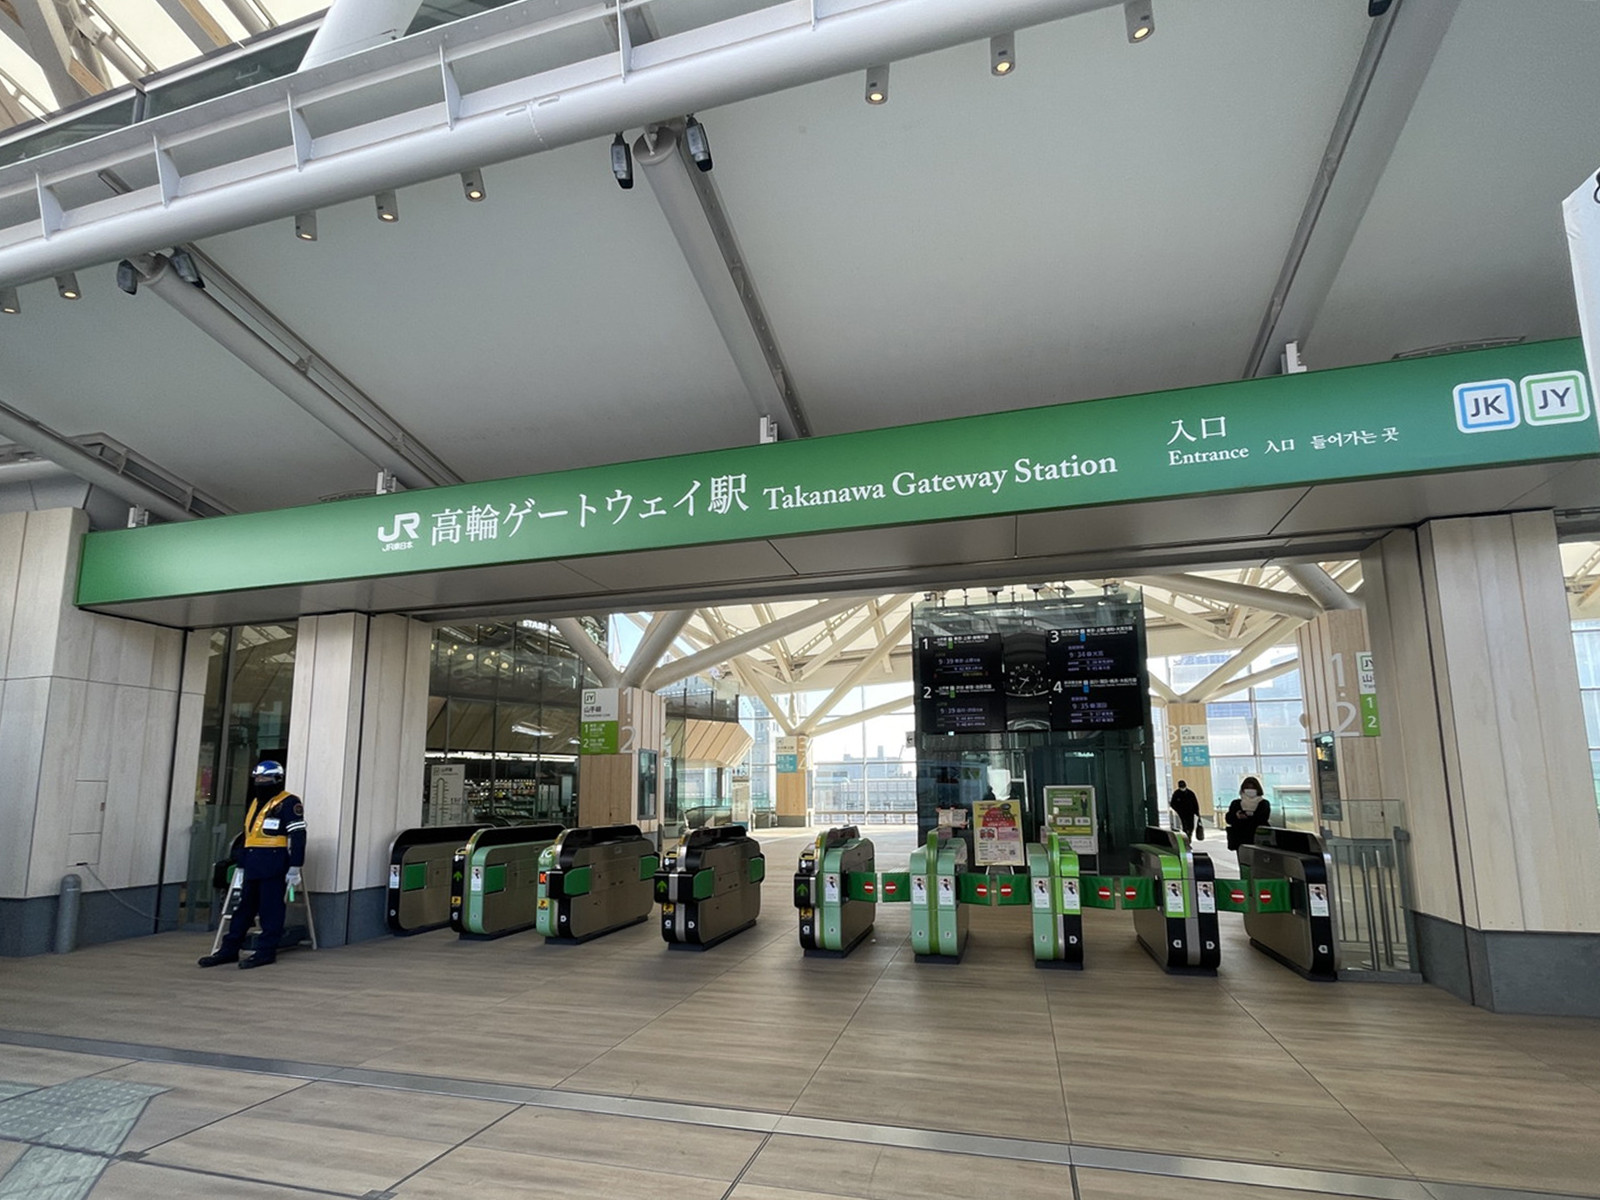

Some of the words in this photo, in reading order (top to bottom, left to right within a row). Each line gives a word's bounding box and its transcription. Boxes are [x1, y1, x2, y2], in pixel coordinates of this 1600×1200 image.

[1470, 394, 1504, 418] JK
[1537, 387, 1571, 410] JY
[1166, 415, 1227, 446] 入口
[1310, 430, 1377, 451] 들어가는
[1381, 426, 1400, 443] 곳
[1168, 446, 1250, 466] Entrance
[1264, 438, 1295, 454] 入口
[762, 483, 886, 511] Takanawa
[892, 471, 1009, 496] Gateway
[1014, 454, 1118, 484] Station
[431, 473, 750, 547] 高輪ゲートウェイ駅
[377, 511, 420, 543] JR
[922, 637, 929, 650] 1
[1050, 630, 1060, 643] 3
[1331, 652, 1345, 687] 1
[923, 686, 932, 699] 2
[1053, 680, 1063, 694] 4
[1366, 697, 1373, 709] 1
[584, 724, 589, 733] 1
[1335, 701, 1360, 737] 2
[1367, 715, 1378, 728] 2
[583, 738, 589, 748] 2
